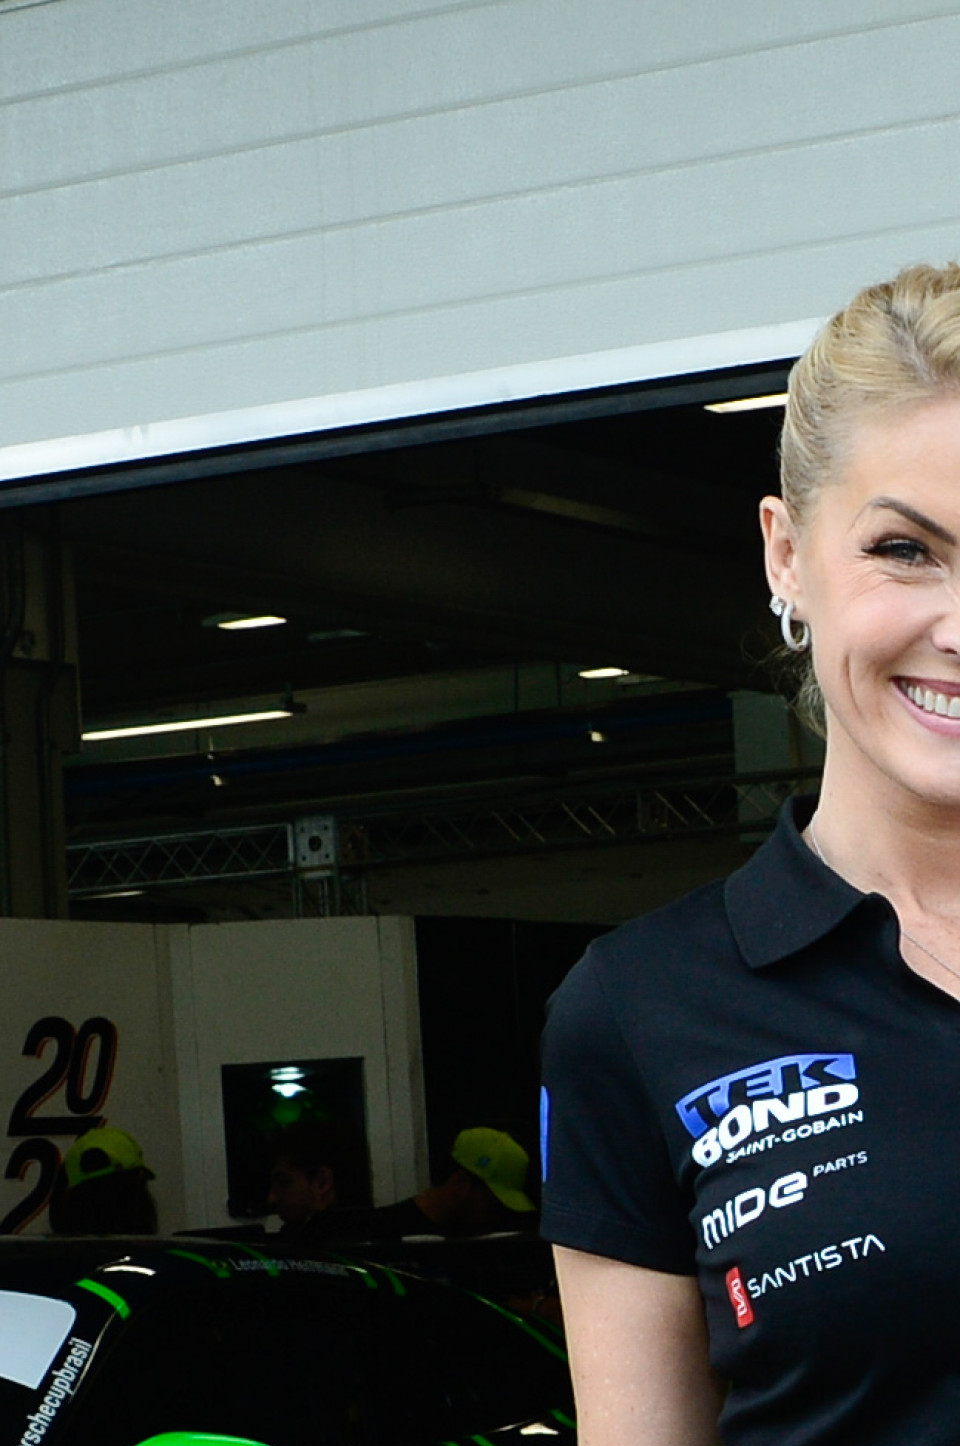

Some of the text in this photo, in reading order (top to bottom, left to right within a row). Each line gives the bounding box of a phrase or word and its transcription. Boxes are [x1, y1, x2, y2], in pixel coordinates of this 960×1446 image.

[7, 1016, 117, 1137] 20
[692, 1083, 858, 1167] BOND
[726, 1110, 864, 1163] SAINT-GOBAIN
[813, 1151, 867, 1177] PARTS
[746, 1233, 886, 1299] SANTISTA
